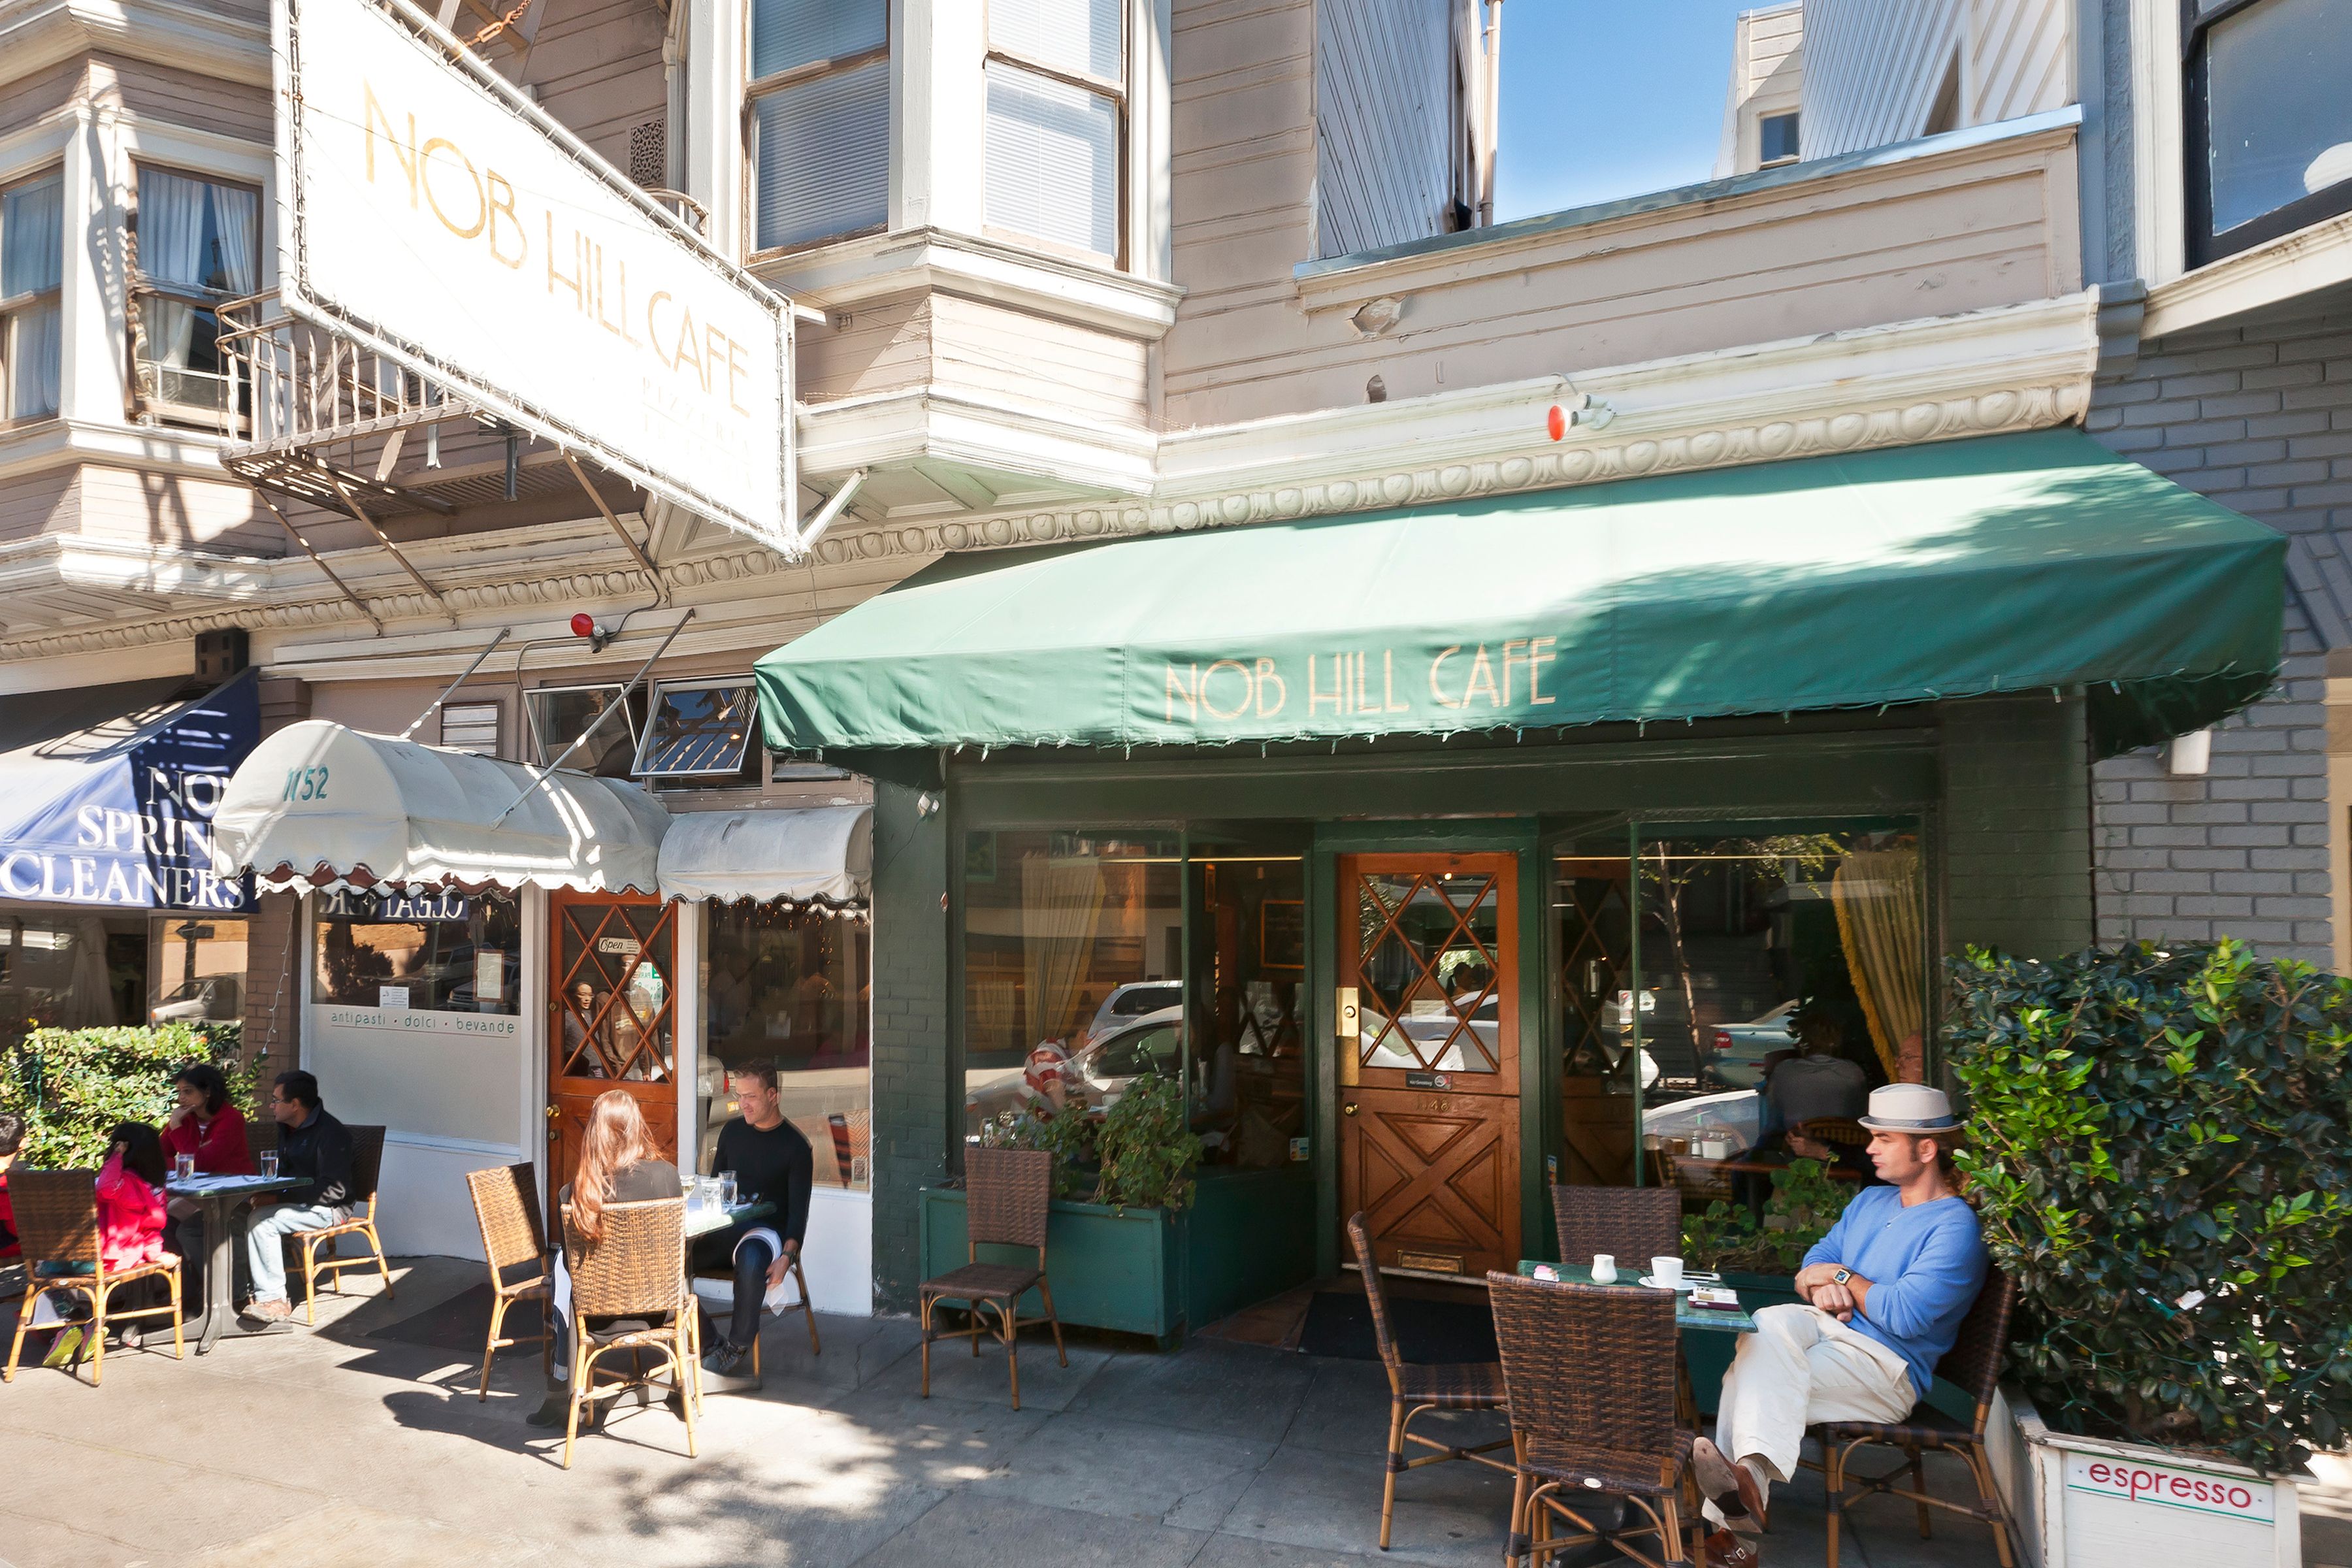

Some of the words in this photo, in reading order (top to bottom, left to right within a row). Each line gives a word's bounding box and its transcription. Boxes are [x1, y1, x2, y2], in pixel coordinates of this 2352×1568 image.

[363, 76, 529, 270] NOB
[546, 210, 644, 349] HILL
[647, 290, 751, 418] CAFE
[1166, 657, 1286, 724] NOB
[1309, 649, 1410, 717] HILL
[1429, 636, 1558, 710] CAFE
[146, 766, 231, 817] NO
[283, 766, 329, 802] 1152
[77, 805, 215, 860] SPRIN
[0, 849, 246, 909] CLEANERS
[600, 939, 623, 951] Open
[331, 1011, 385, 1026] antipasti
[404, 1015, 436, 1028] dolci
[456, 1017, 515, 1034] bevande
[2089, 1463, 2252, 1509] espresso
